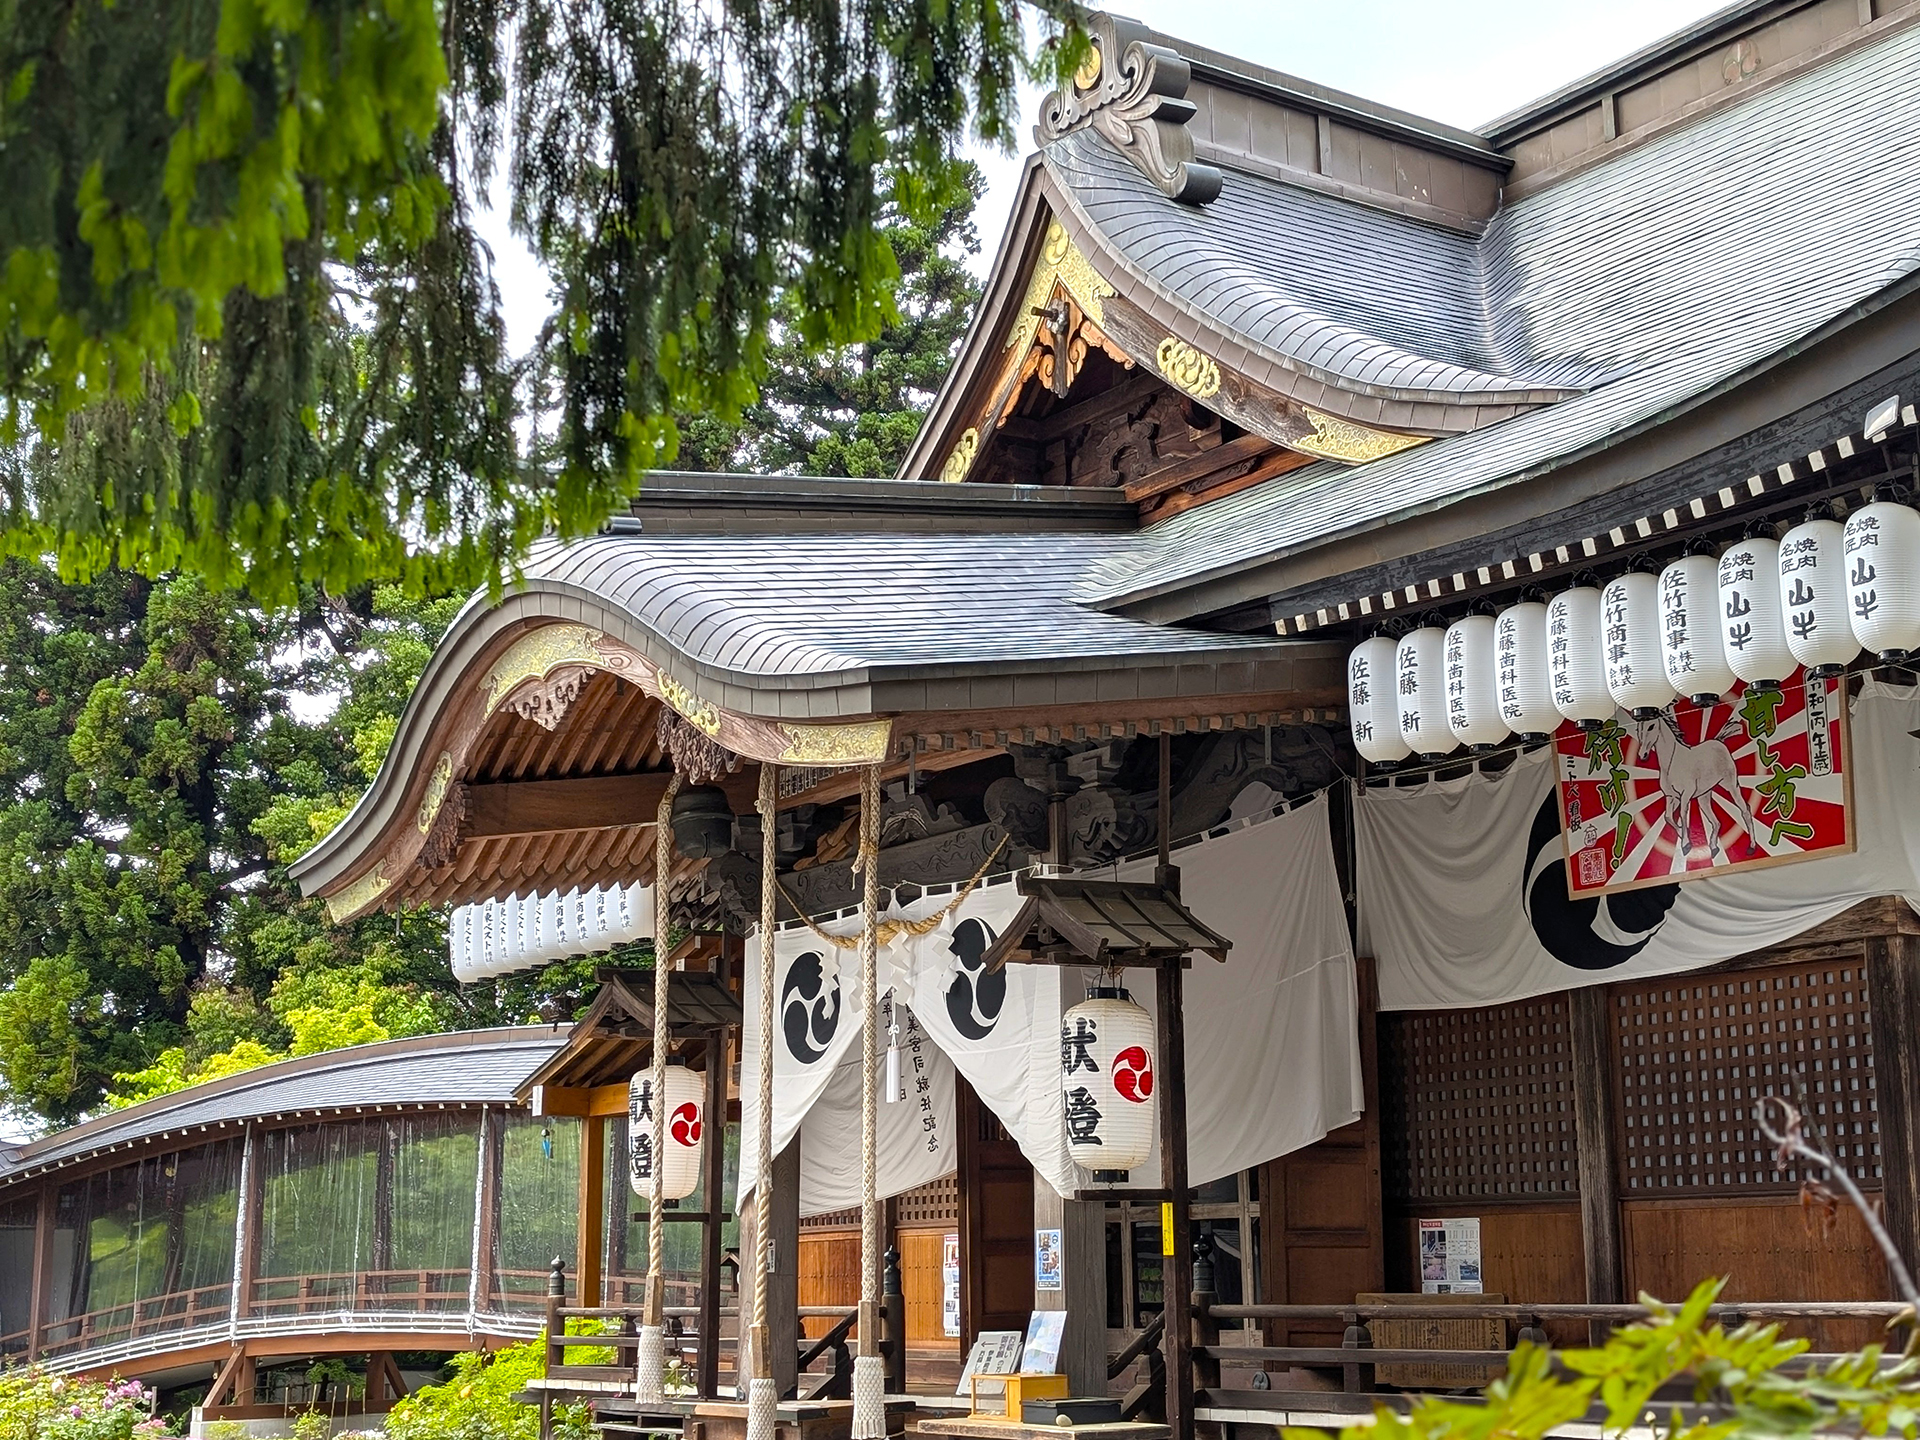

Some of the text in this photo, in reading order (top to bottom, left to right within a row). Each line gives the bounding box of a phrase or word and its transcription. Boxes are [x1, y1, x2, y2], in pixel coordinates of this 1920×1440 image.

[1732, 552, 1755, 581] 焼肉
[1794, 538, 1818, 568] 焼肉
[1856, 516, 1880, 547] 焼肉
[1605, 585, 1629, 664] 佐竹商事
[1662, 570, 1690, 650] 佐竹商事
[1447, 630, 1469, 729] 佐藤歯科医院
[1498, 618, 1523, 719] 佐藤歯科医院
[1550, 602, 1574, 705] 佐藤歯科医院
